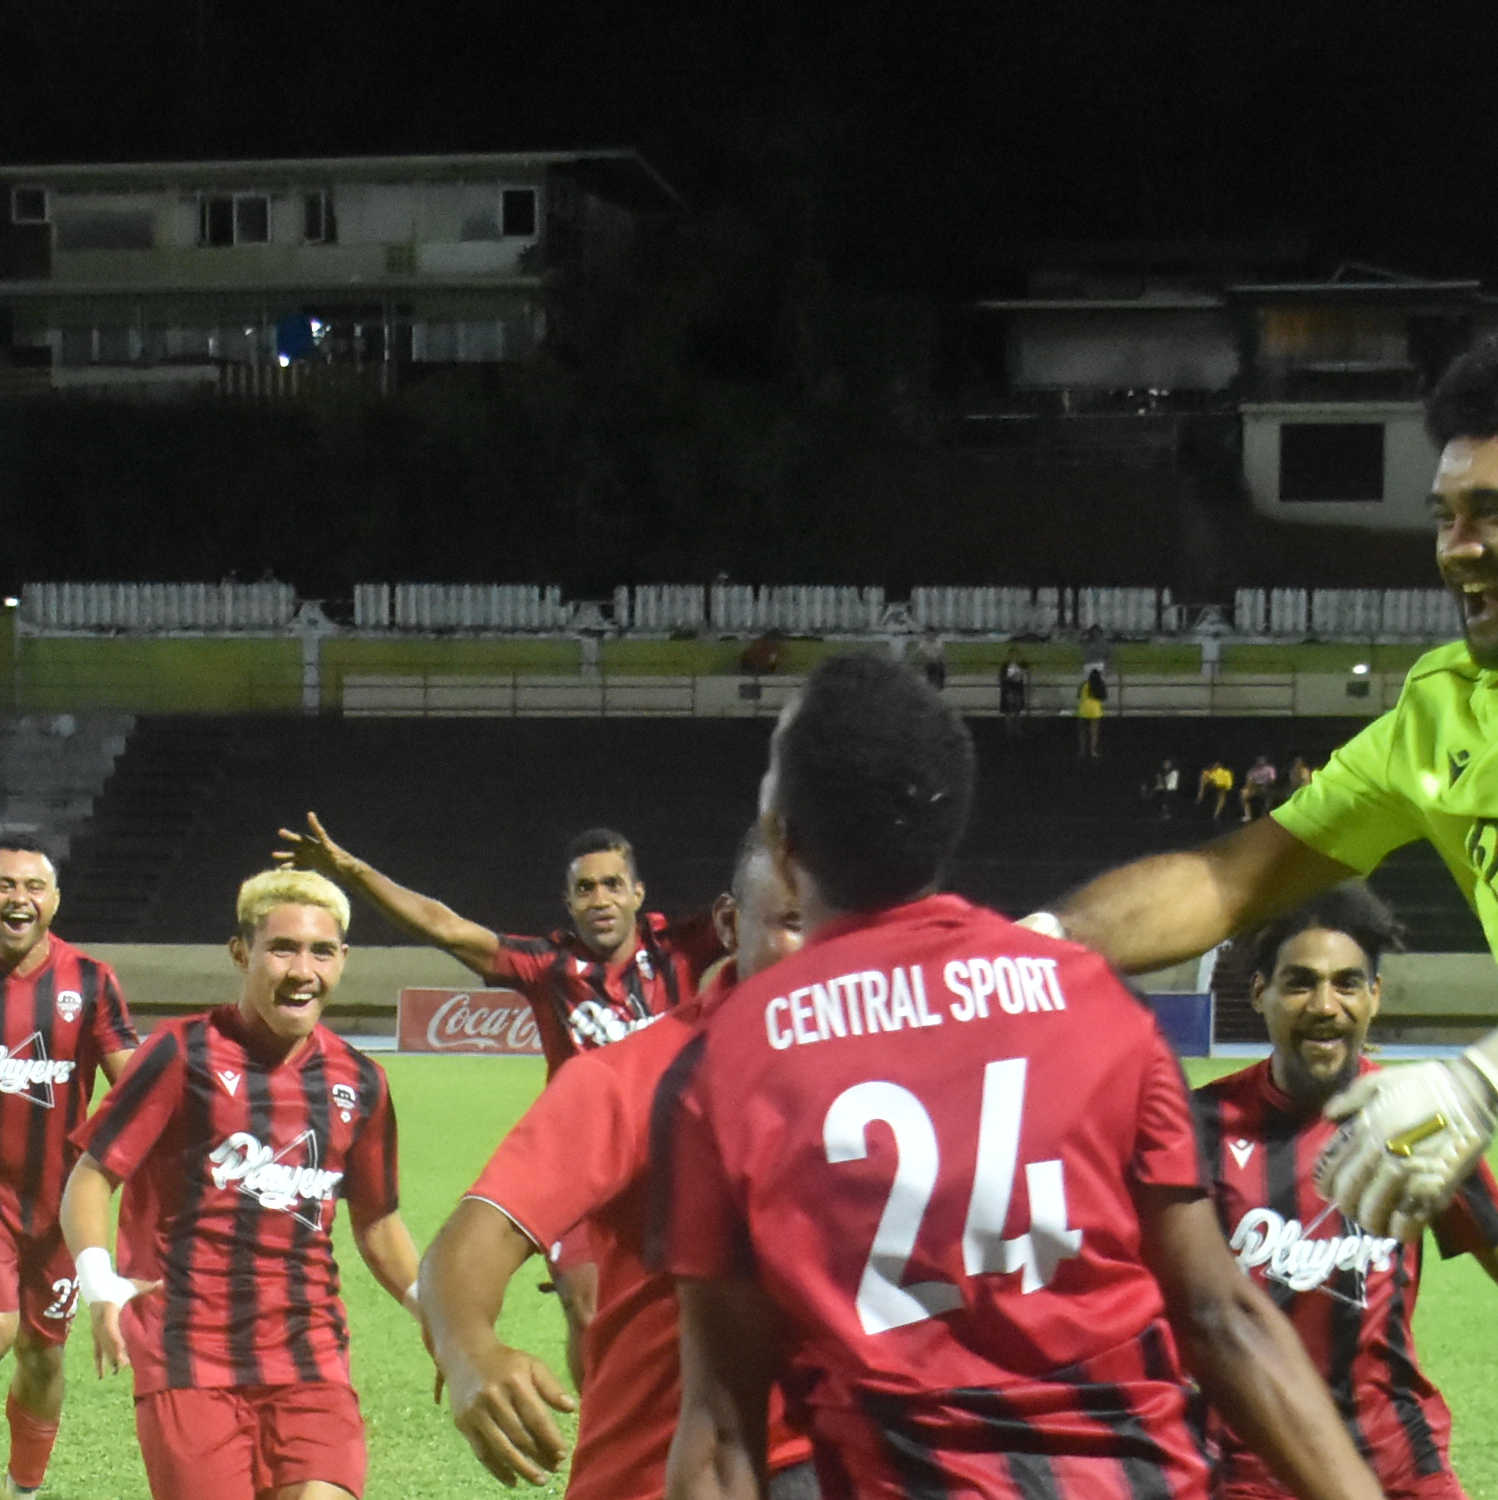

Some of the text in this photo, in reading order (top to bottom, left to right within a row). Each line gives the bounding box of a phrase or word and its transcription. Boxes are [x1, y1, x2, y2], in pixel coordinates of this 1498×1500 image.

[427, 993, 543, 1049] Coca-C
[765, 956, 1066, 1050] CENTRAL SPORT
[822, 1057, 1083, 1336] 24
